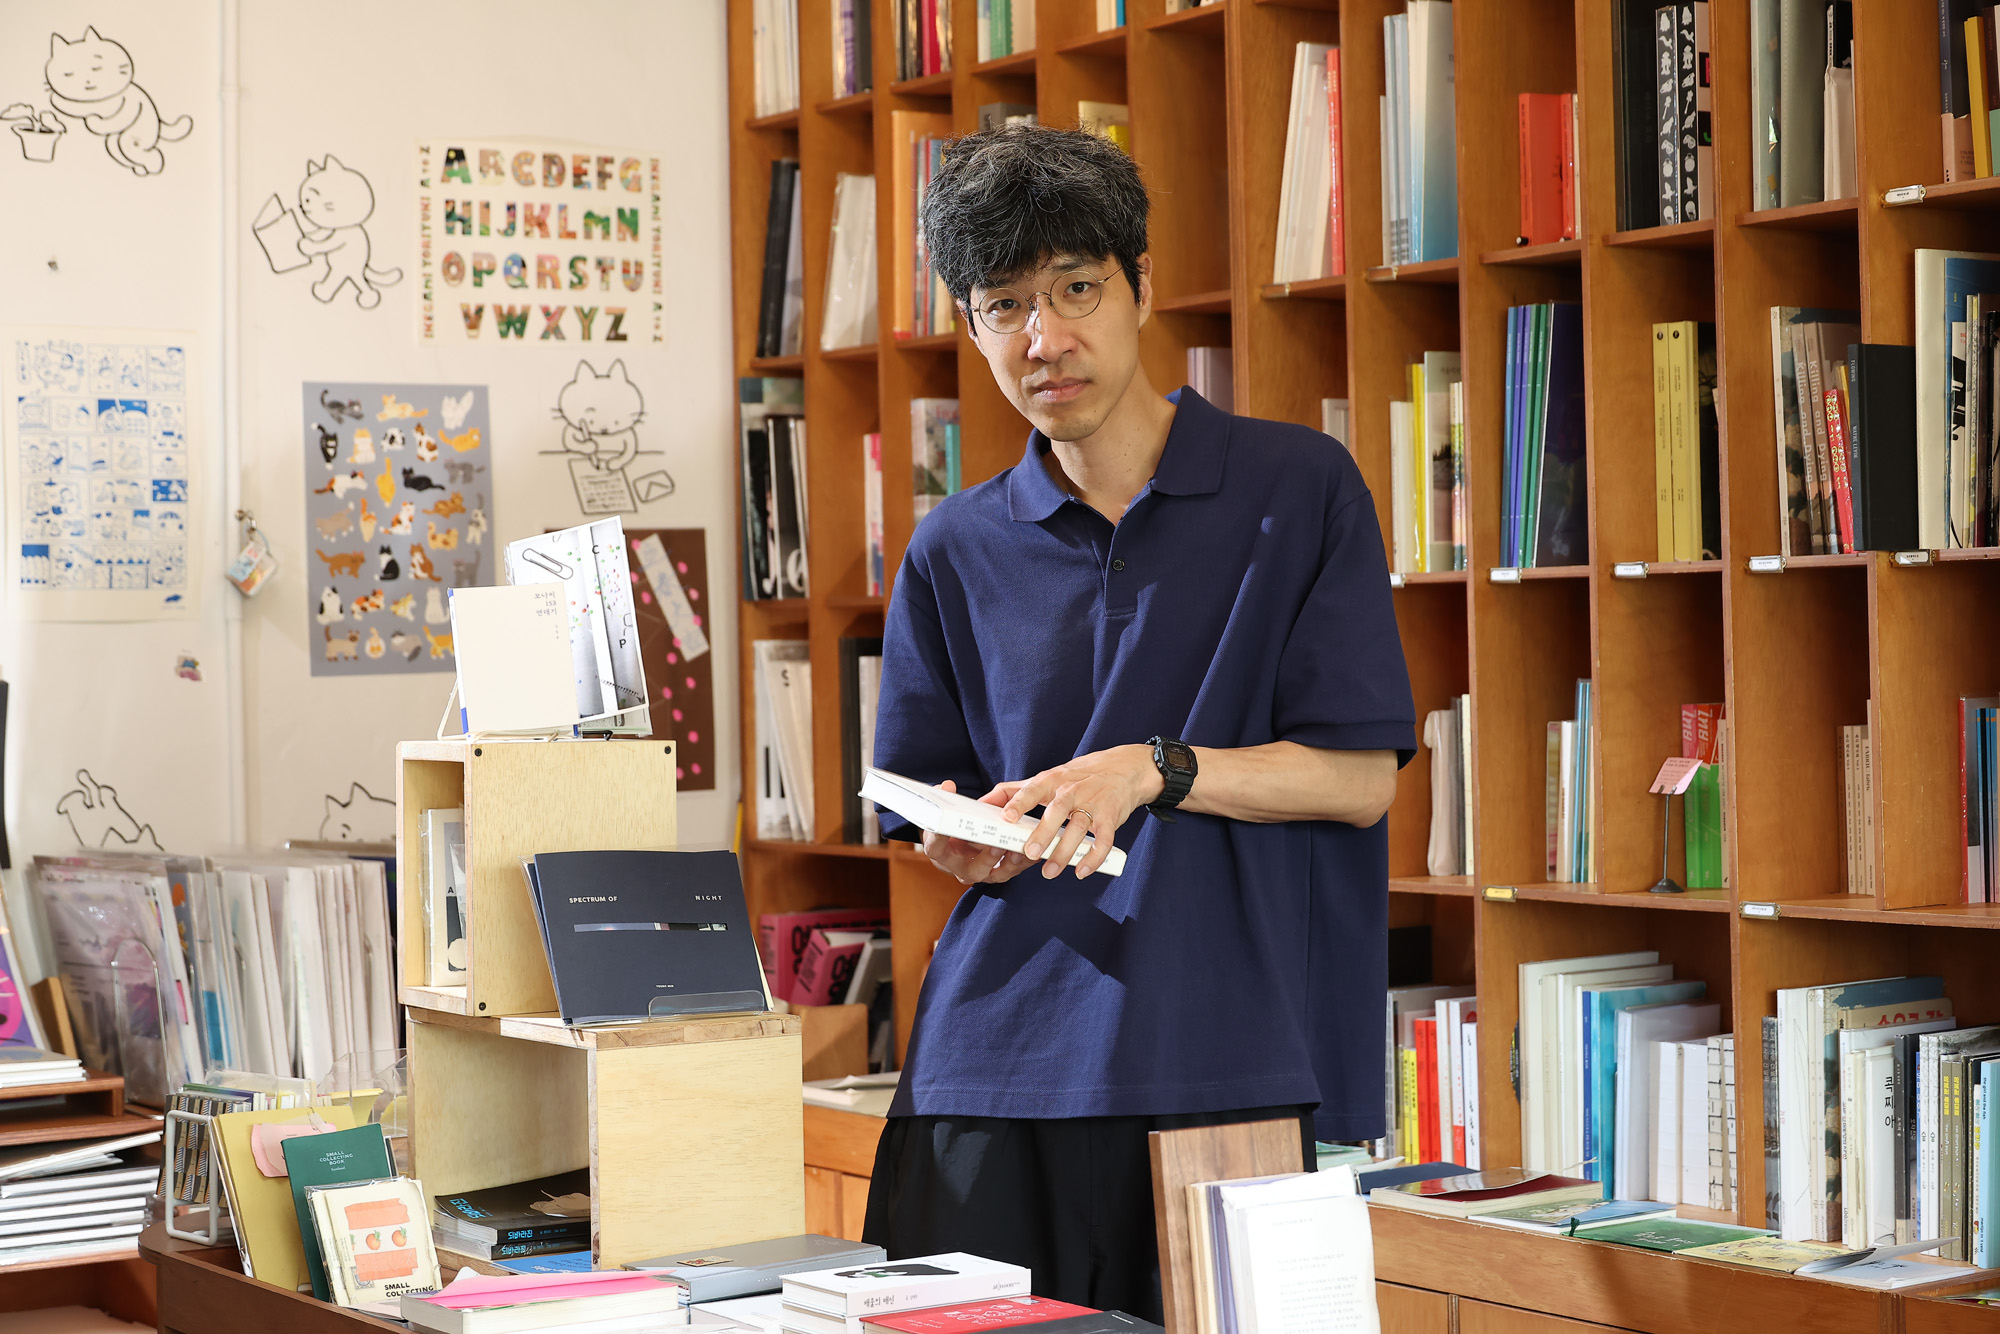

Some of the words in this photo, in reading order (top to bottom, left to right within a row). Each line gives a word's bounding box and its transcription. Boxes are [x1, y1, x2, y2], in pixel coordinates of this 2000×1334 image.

[1795, 361, 1807, 404] Killing
[1809, 361, 1820, 403] Killing
[1800, 413, 1811, 436] and
[1815, 411, 1825, 435] and
[1803, 444, 1814, 482] Dying
[1818, 443, 1829, 482] Dying
[533, 590, 556, 600] 모나미
[569, 896, 606, 904] SPECTRUM
[319, 1153, 354, 1162] COLLECTING
[384, 1282, 410, 1290] SMALL
